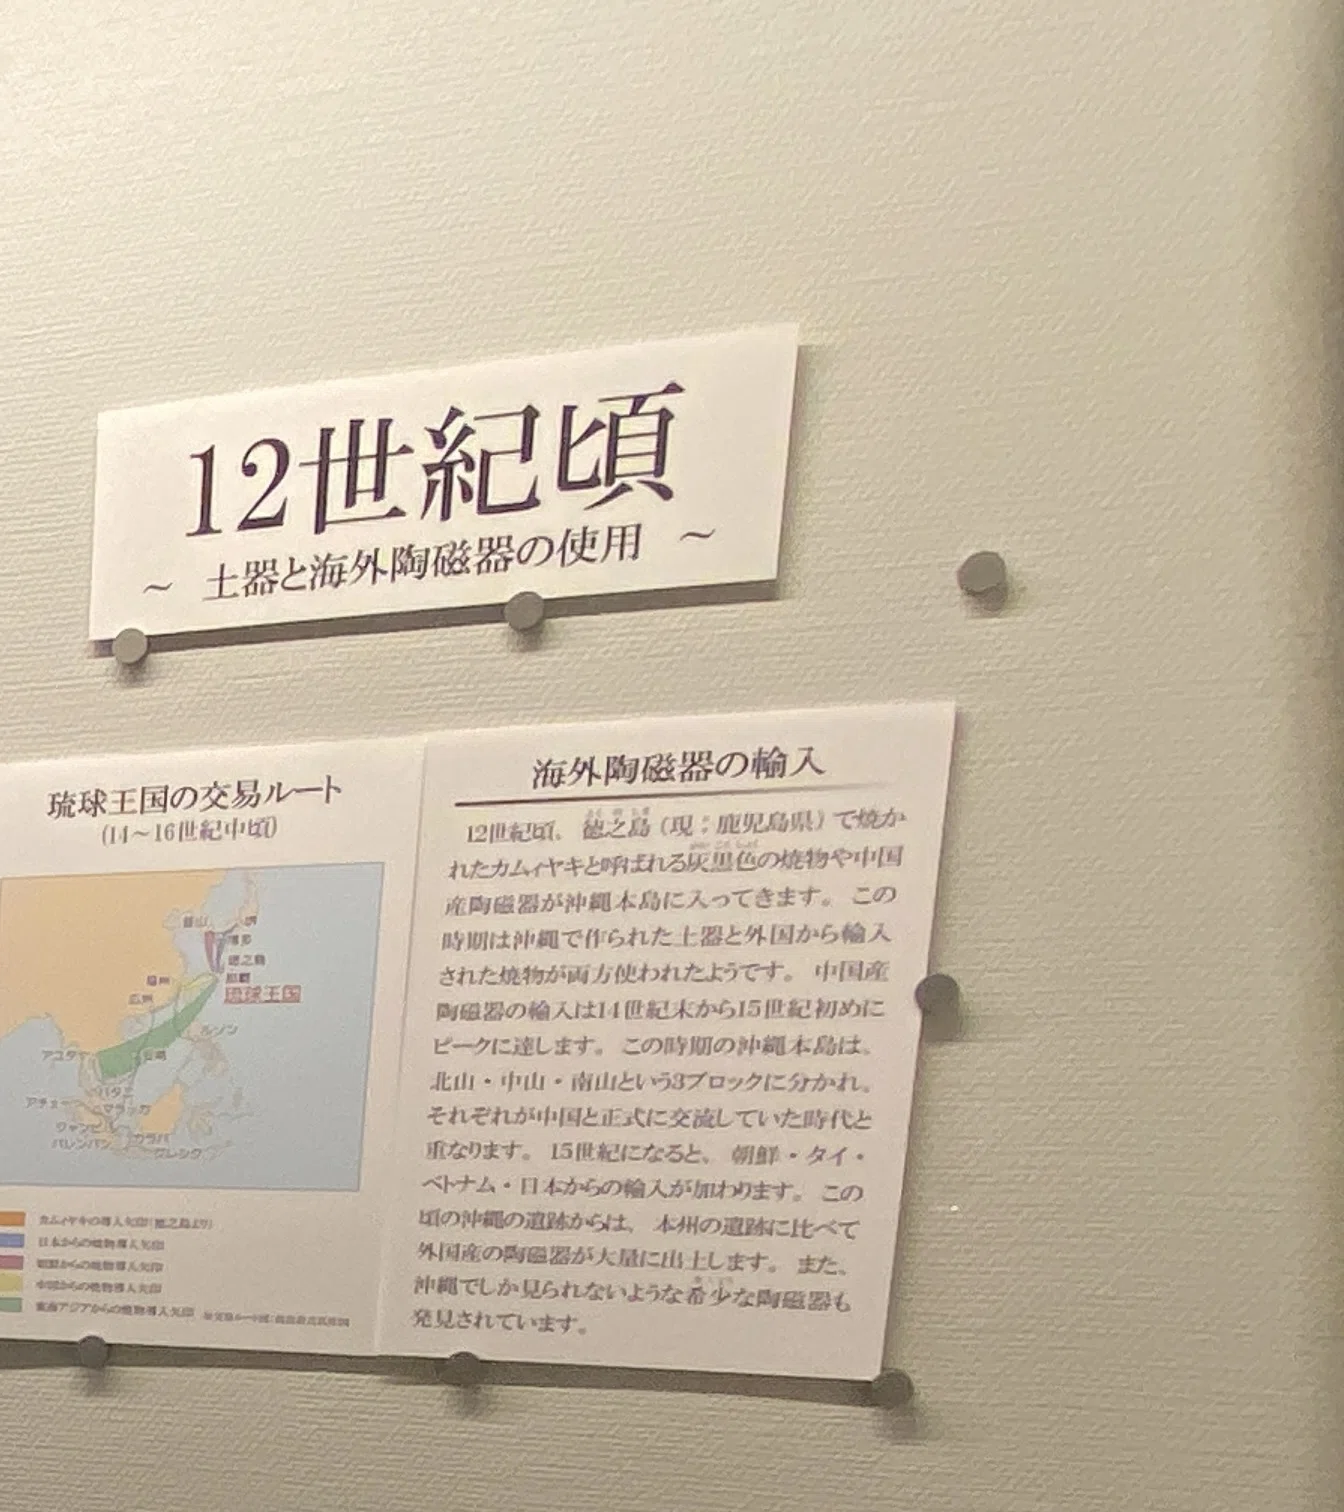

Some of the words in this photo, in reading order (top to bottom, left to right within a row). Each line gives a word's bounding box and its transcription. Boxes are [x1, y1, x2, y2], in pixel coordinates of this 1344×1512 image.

[186, 381, 686, 538] 12世紀頃
[532, 747, 825, 788] 海外陶磁器の輸入
[47, 776, 342, 819] 琉球王国の交易ルート
